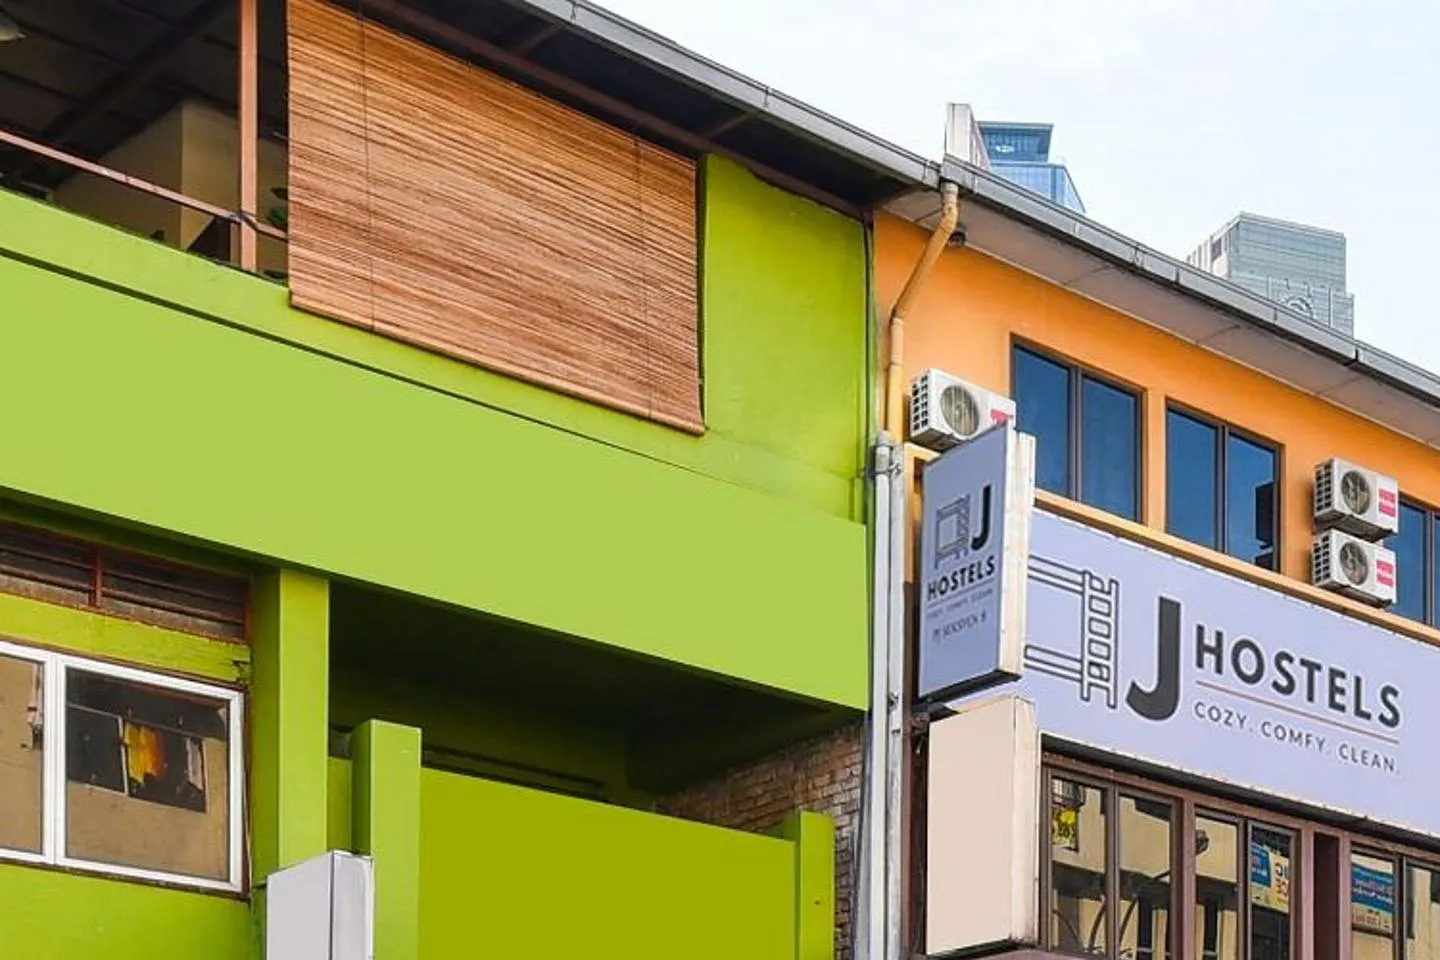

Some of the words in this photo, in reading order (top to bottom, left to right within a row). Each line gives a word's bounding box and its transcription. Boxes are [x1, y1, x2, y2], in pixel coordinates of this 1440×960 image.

[970, 483, 992, 551] J
[927, 555, 996, 602] HOSTELS
[1126, 596, 1181, 721] J
[1195, 623, 1401, 728] HOSTELS
